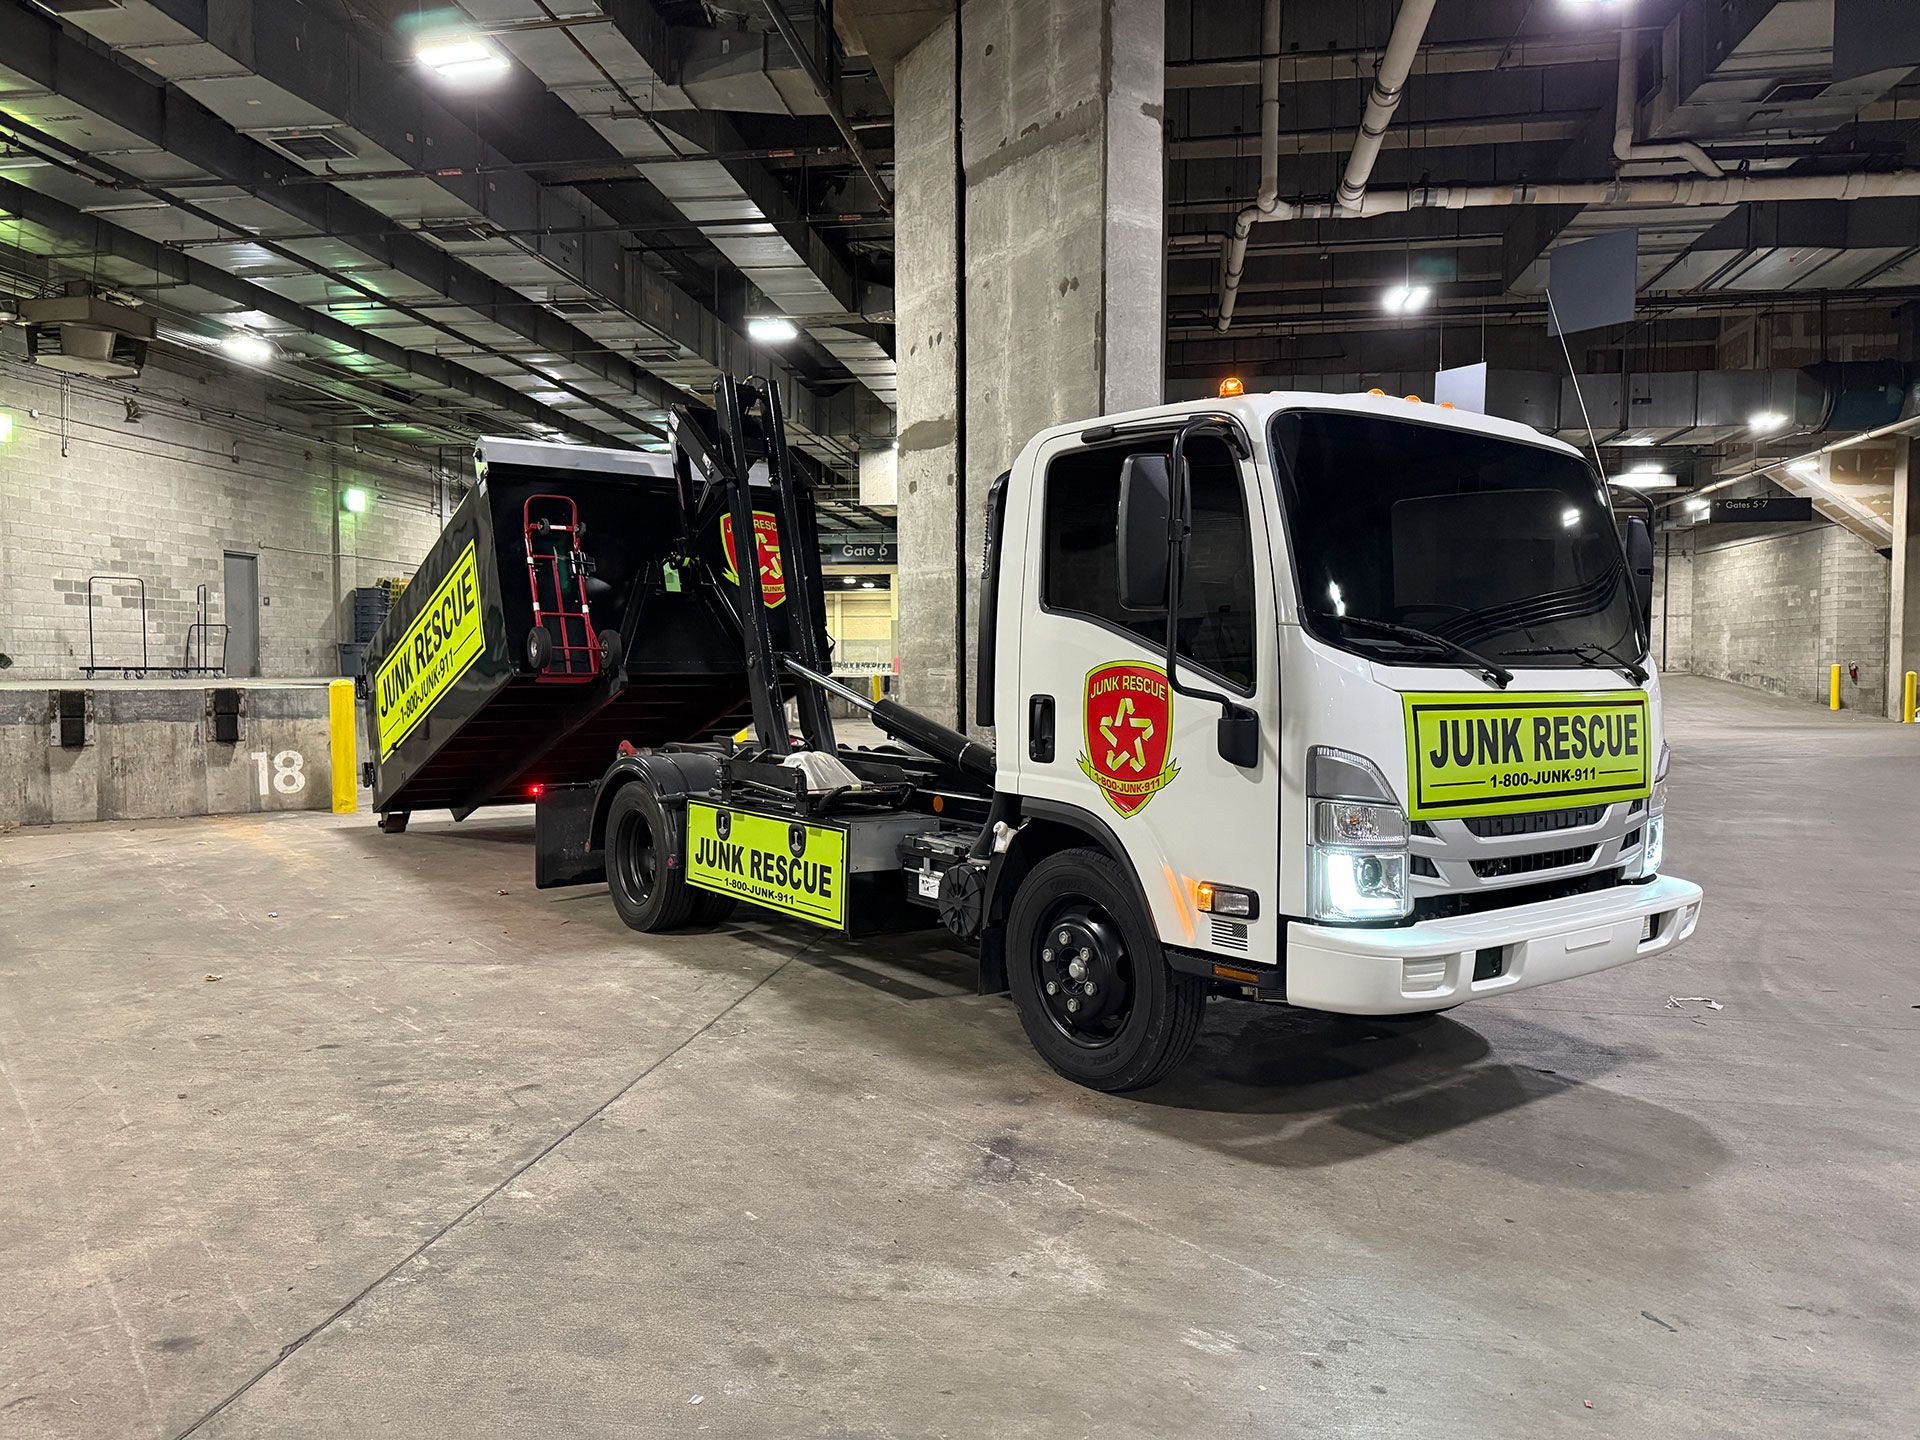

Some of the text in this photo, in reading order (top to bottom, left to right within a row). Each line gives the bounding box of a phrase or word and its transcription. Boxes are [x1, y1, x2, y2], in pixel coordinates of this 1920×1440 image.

[1725, 500, 1768, 509] Gates 5-7
[842, 544, 888, 556] Gate 6
[380, 566, 475, 718] JUNK RESCUE
[399, 647, 454, 724] 1-800-JUNK-911
[1090, 675, 1166, 701] JUNK RESCUE
[1430, 714, 1639, 768] JUNK RESCUE
[251, 750, 305, 795] 18
[1094, 772, 1160, 793] 1-800-JUNK-911
[1490, 767, 1596, 788] 1-800-JUNK-911
[695, 837, 832, 899] JUNK RESCUE
[723, 877, 794, 904] 1-800-JUNK-911
